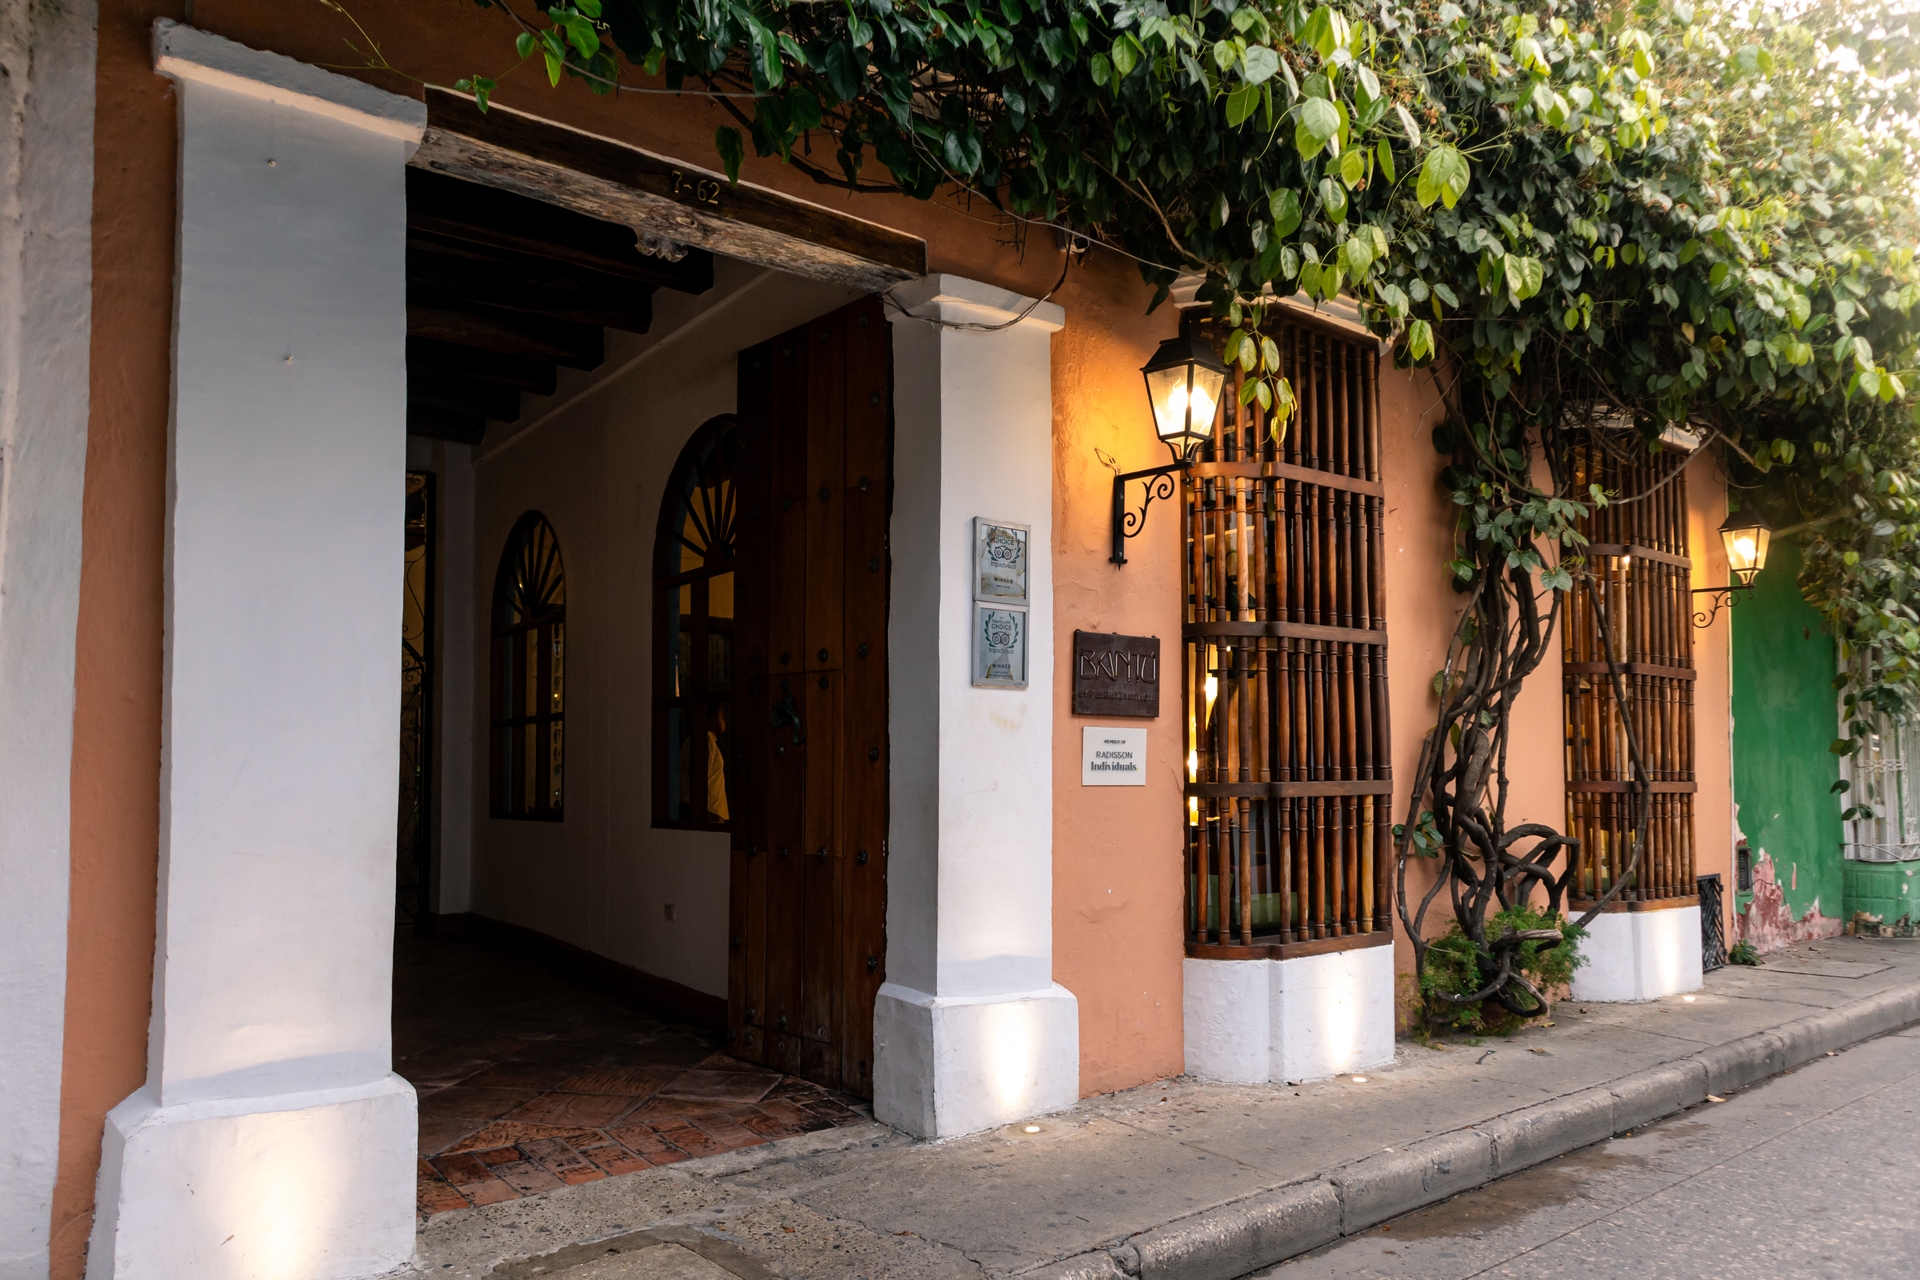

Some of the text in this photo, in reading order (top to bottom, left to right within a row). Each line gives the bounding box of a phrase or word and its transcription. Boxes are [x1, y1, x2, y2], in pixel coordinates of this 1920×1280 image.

[671, 170, 720, 205] 7-62
[994, 537, 1015, 546] CHOICE
[994, 576, 1014, 584] WINNER
[991, 623, 1012, 631] CHOICE
[1095, 750, 1133, 759] RADISSON
